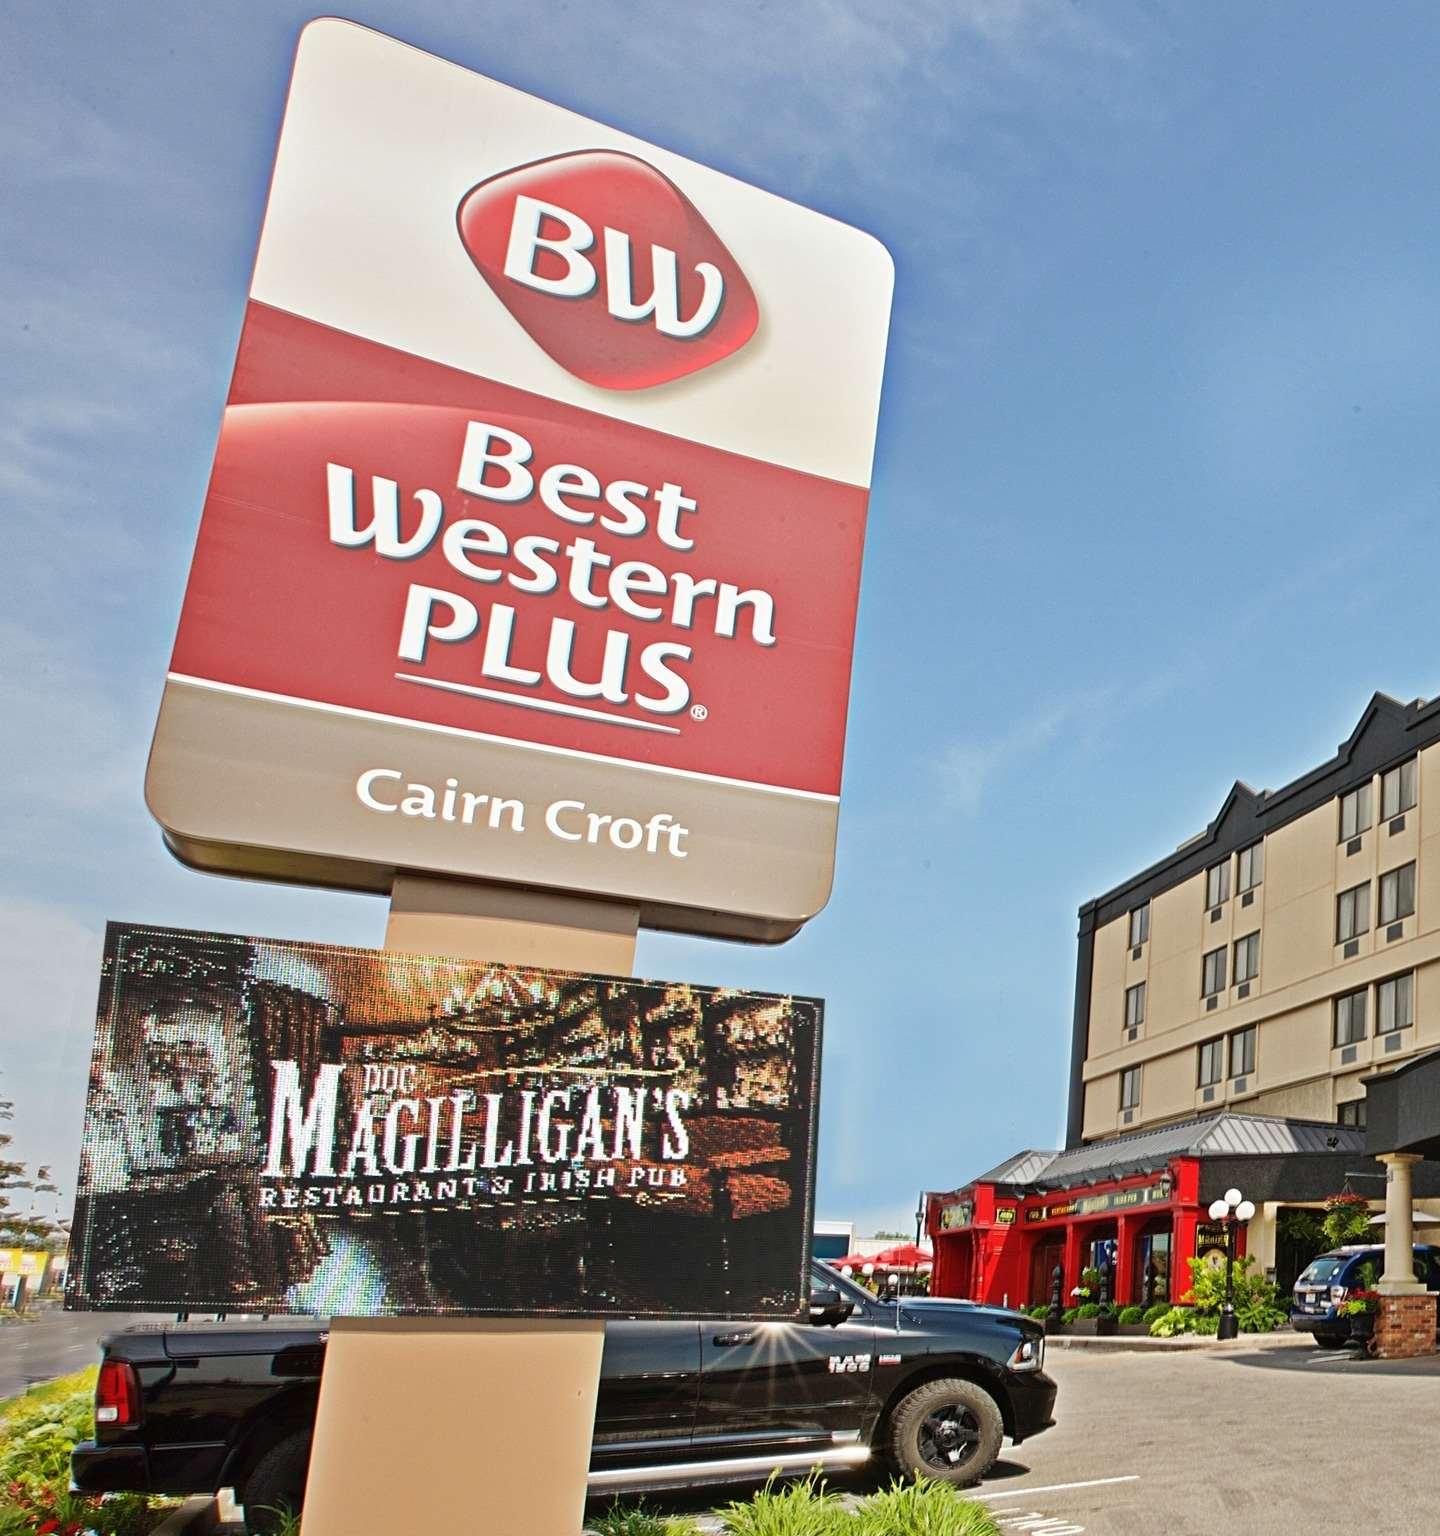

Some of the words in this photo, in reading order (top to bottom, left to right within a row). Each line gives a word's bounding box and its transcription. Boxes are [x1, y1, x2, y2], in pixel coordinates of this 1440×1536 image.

[503, 195, 724, 338] BW
[457, 421, 698, 550] Best
[327, 463, 777, 645] Western
[356, 768, 525, 832] Cairn
[545, 800, 690, 858] Croft
[258, 1059, 691, 1178] MAGILLIGAN'S
[363, 1064, 418, 1093] DOC
[259, 1177, 478, 1208] RESTAURANT
[490, 1176, 514, 1195] &
[523, 1167, 616, 1193] IRISH
[627, 1166, 687, 1188] PUB
